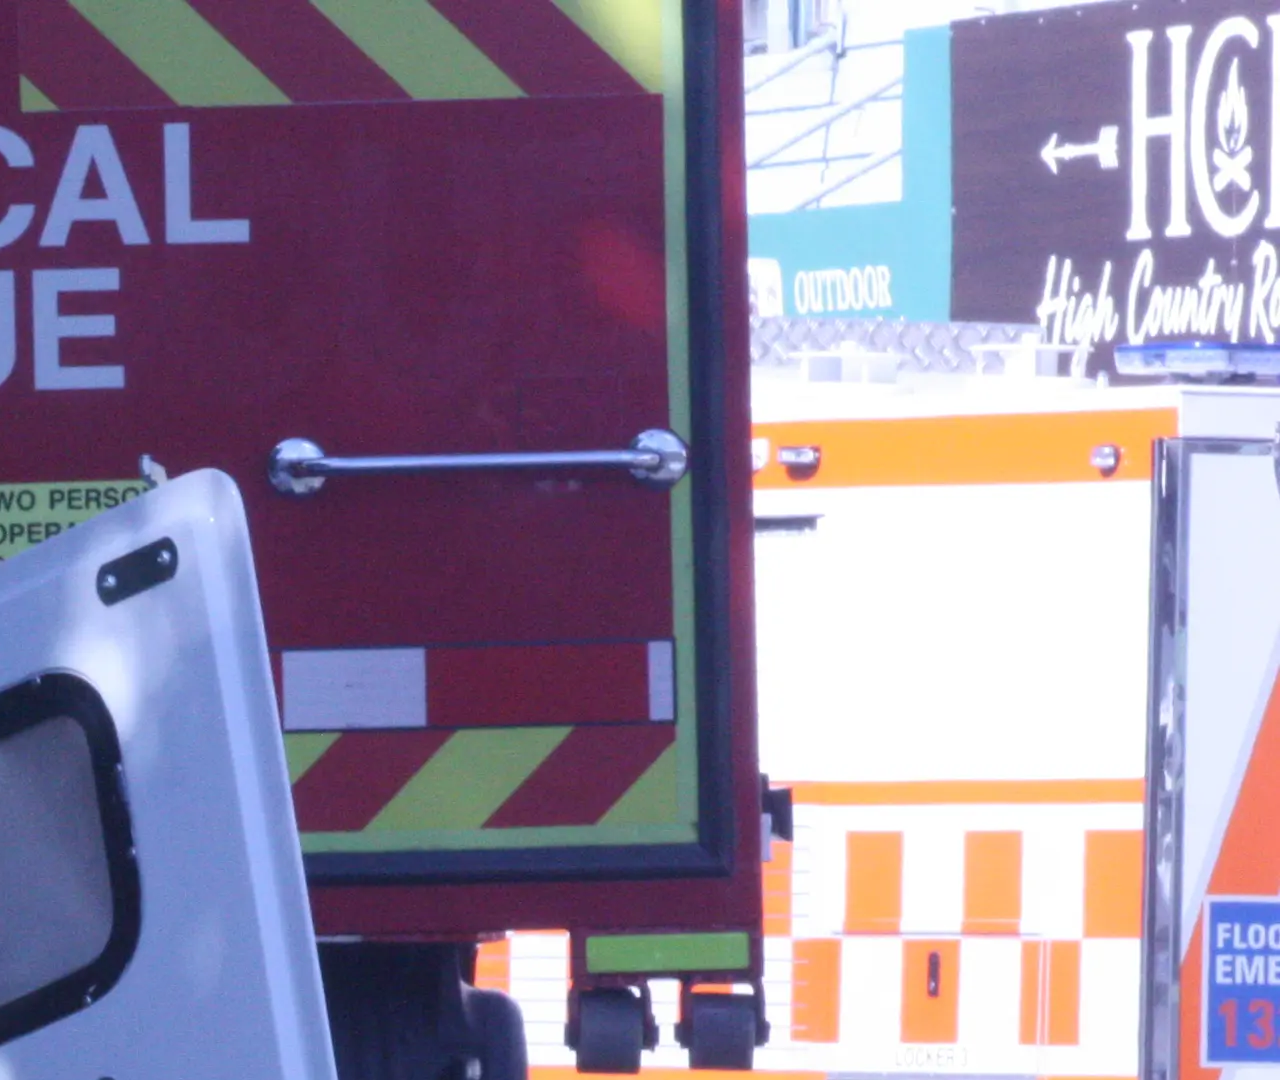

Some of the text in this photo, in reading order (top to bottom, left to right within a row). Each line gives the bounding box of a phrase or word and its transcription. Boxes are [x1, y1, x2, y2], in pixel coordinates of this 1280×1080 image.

[793, 264, 893, 315] OUTDOOR
[1036, 254, 1120, 379] High
[1127, 247, 1244, 345] Country
[48, 487, 150, 511] PERSO
[1218, 998, 1280, 1050] 13
